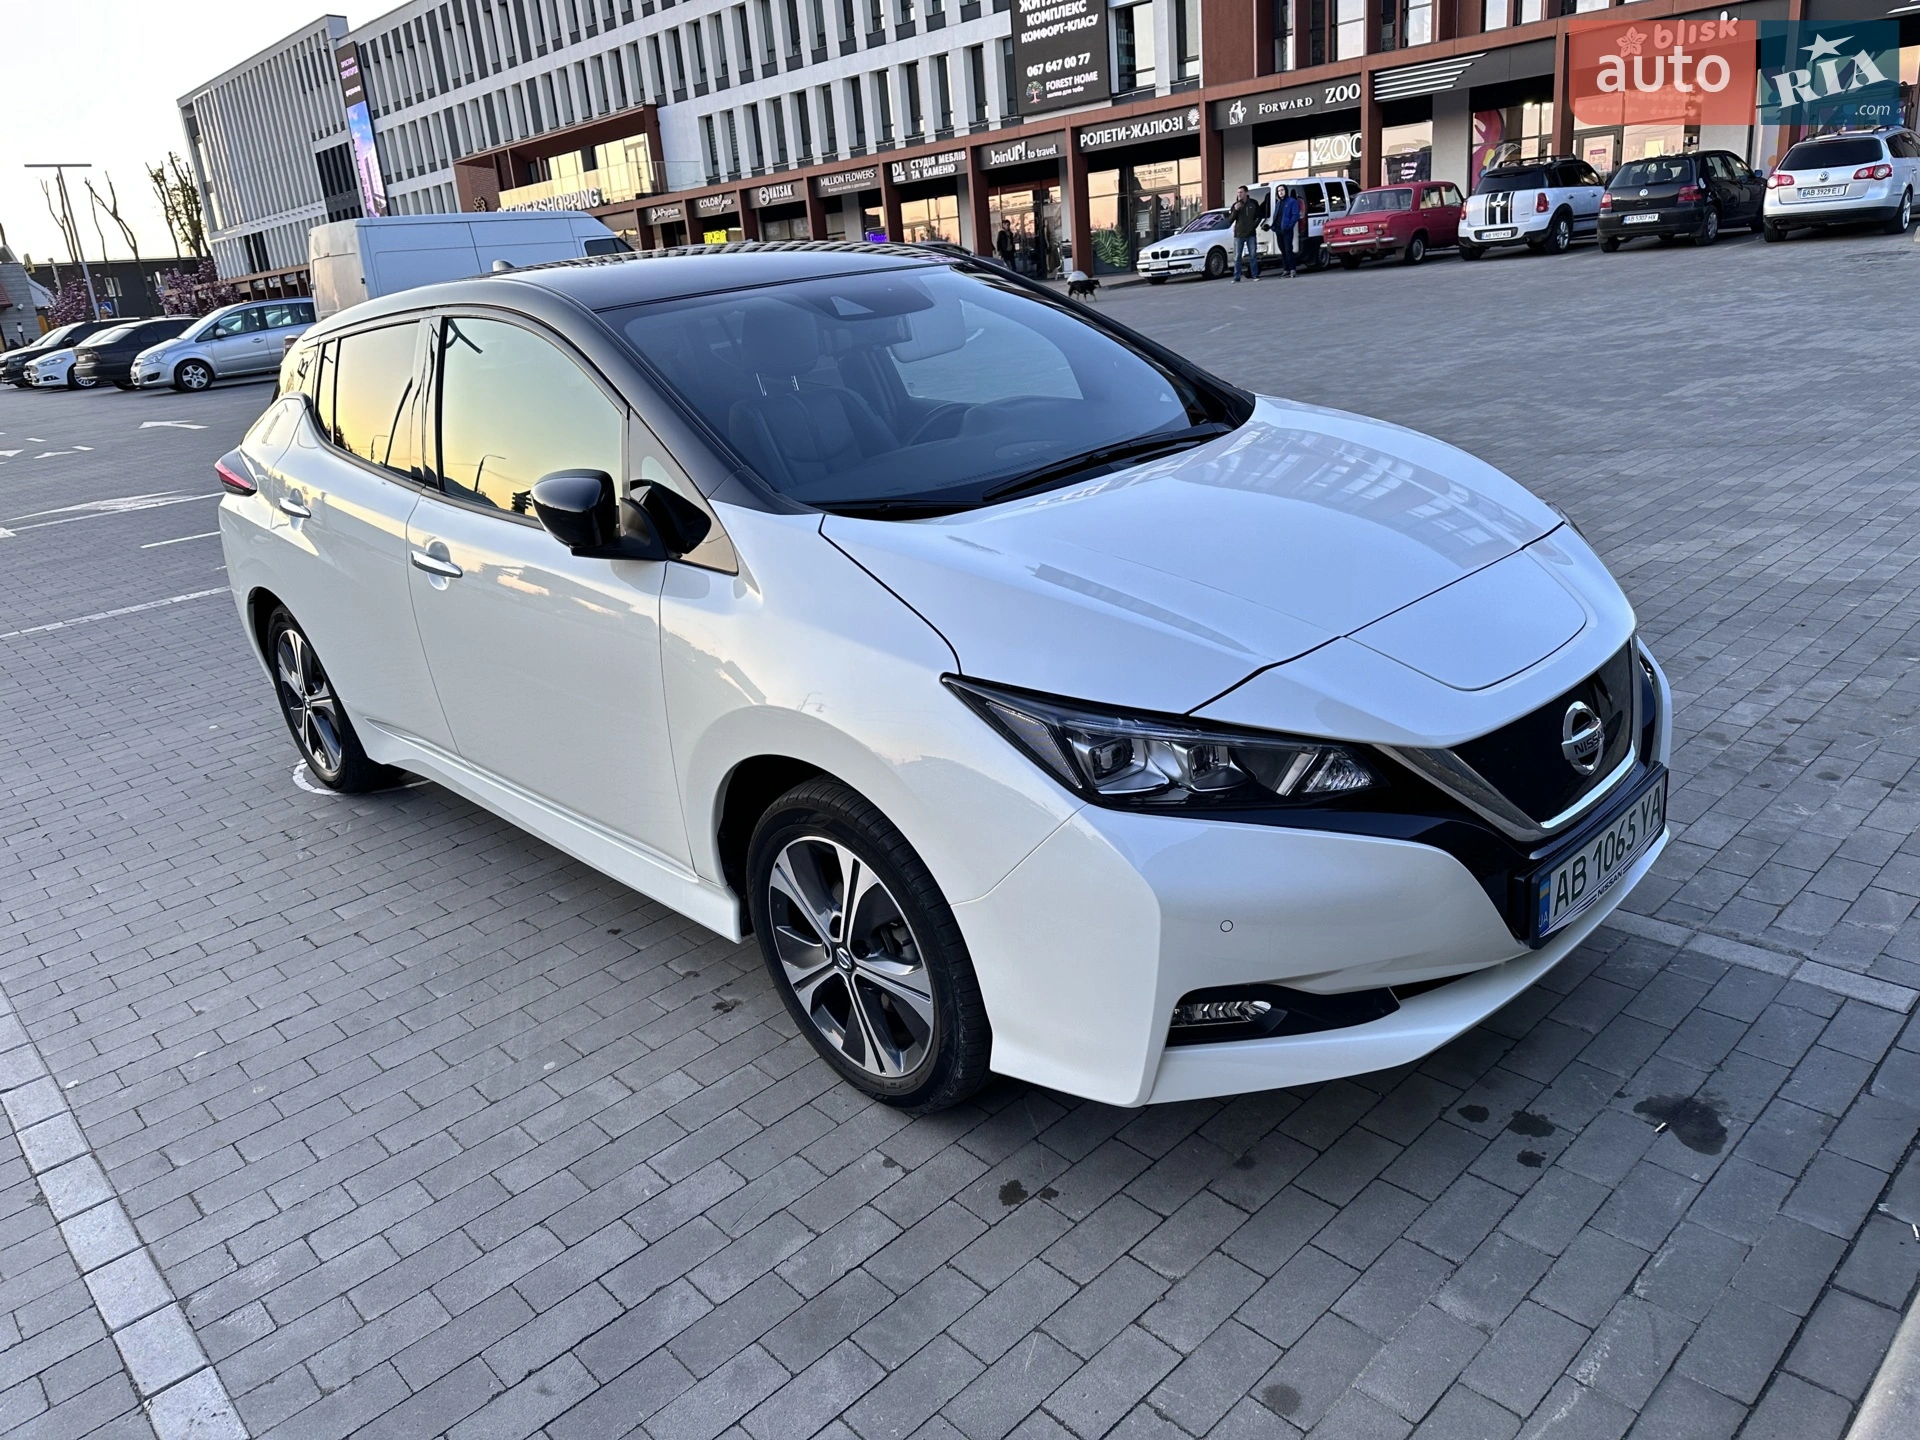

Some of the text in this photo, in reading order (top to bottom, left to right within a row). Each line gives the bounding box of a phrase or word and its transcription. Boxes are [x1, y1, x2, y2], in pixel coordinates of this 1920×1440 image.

[1026, 1, 1087, 27] КОМПЛЕКС
[1021, 14, 1099, 44] КОМФОРТ-КЛАСУ
[1026, 52, 1091, 77] 067 647 00 77
[1046, 71, 1098, 91] FOREST HOME
[1325, 83, 1361, 105] ZOO
[1080, 116, 1184, 148] РОЛЕТИ-ЖАЛЮЗІ
[910, 150, 967, 169] СТУДІЯ МЕБЛІВ
[1027, 150, 1036, 159] to
[1036, 144, 1057, 157] travel
[820, 169, 875, 187] MILLION FLOWERS
[892, 162, 905, 177] DL
[910, 169, 920, 180] ТА
[922, 163, 956, 178] КАМЕНЮ
[496, 188, 602, 212] E&SHOPPING
[769, 184, 793, 199] VATSAK
[1554, 785, 1661, 917] AB 1065 YA
[1597, 868, 1623, 897] NISSAN
